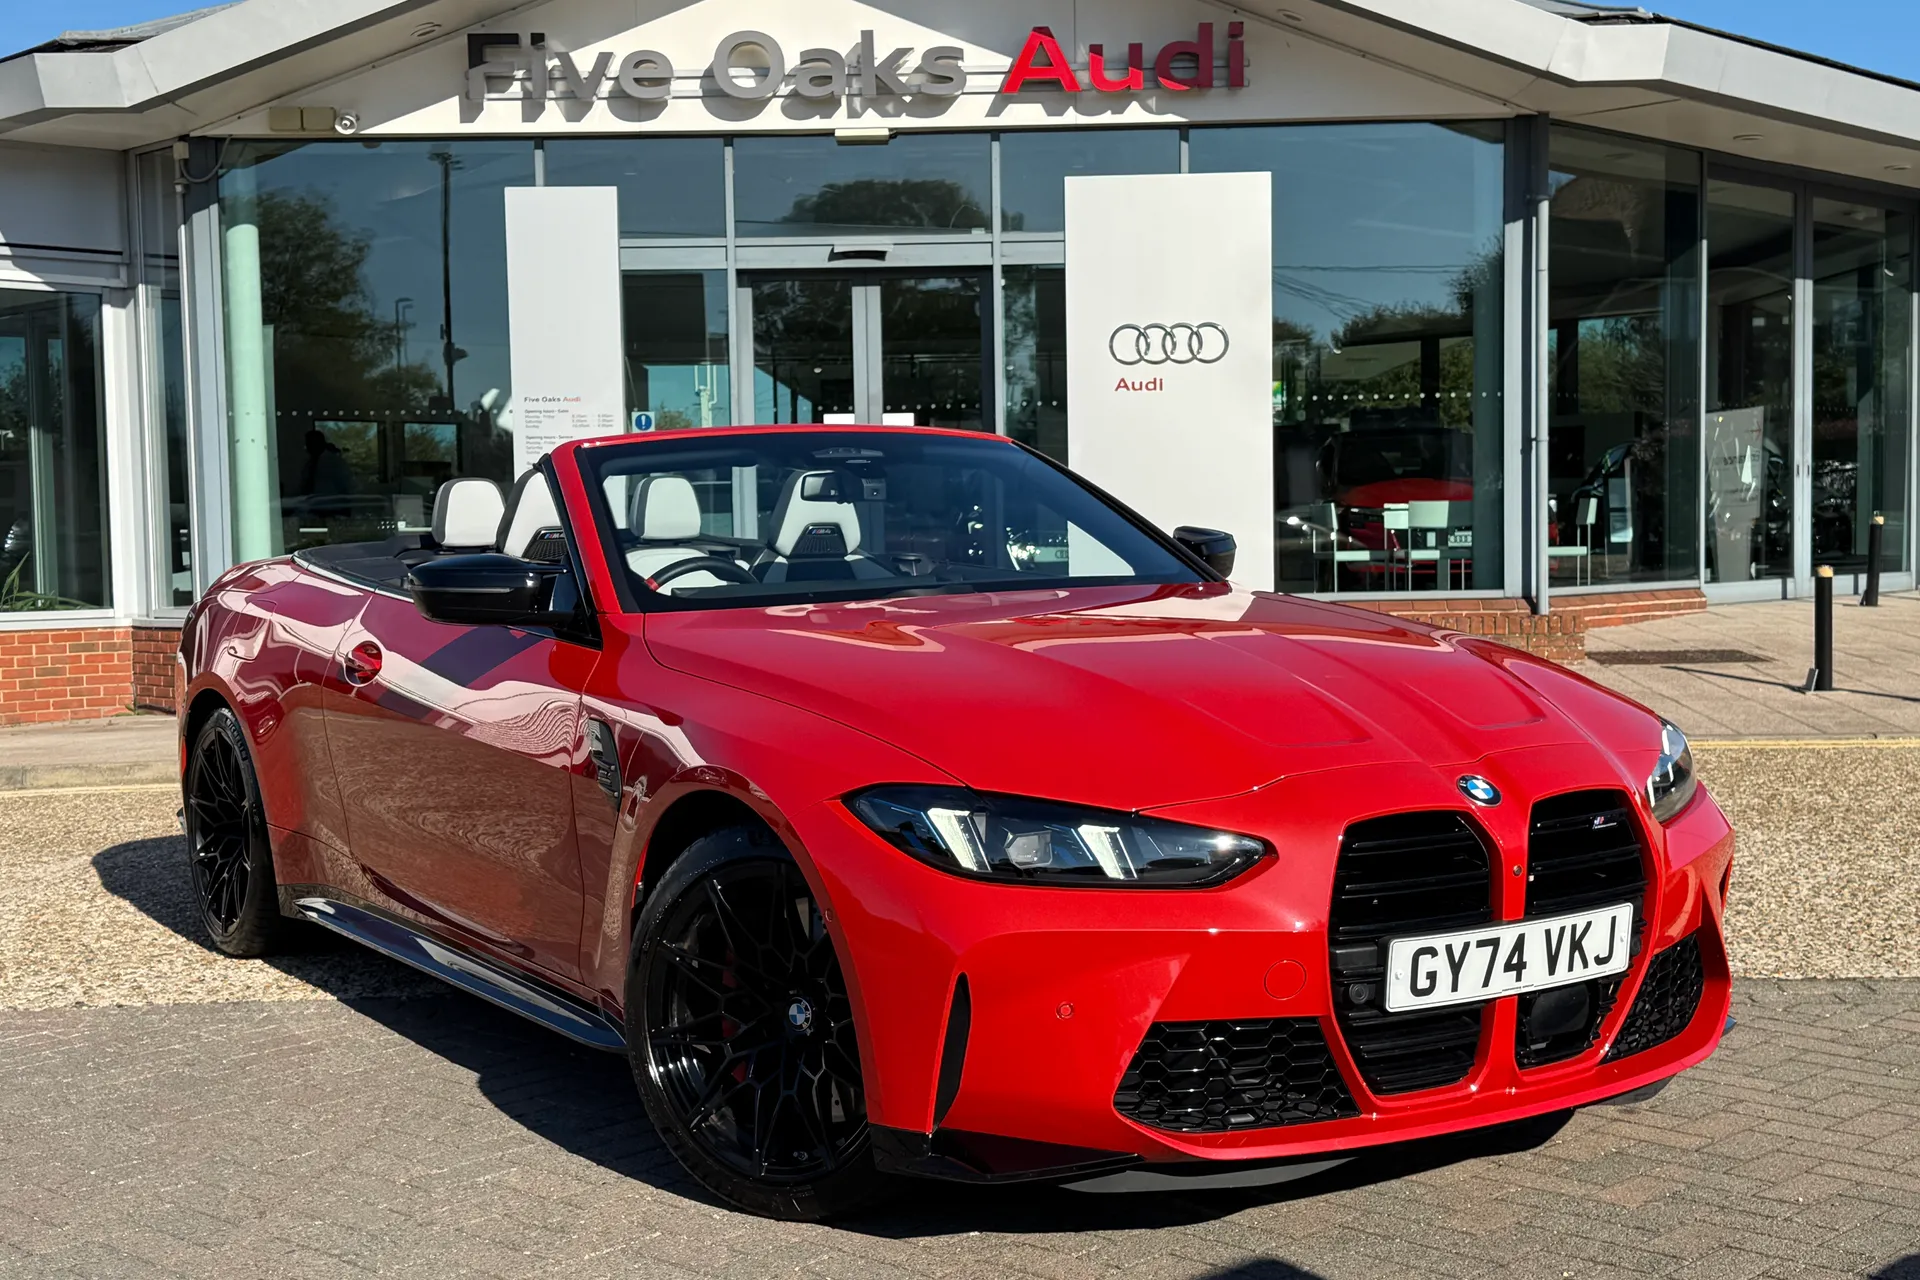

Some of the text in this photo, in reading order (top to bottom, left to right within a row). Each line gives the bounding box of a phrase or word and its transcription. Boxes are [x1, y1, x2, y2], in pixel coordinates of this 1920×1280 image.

[467, 21, 1244, 100] Five Oaks Audi
[1114, 377, 1164, 392] Audi
[1410, 915, 1618, 998] GY74 VKJ
